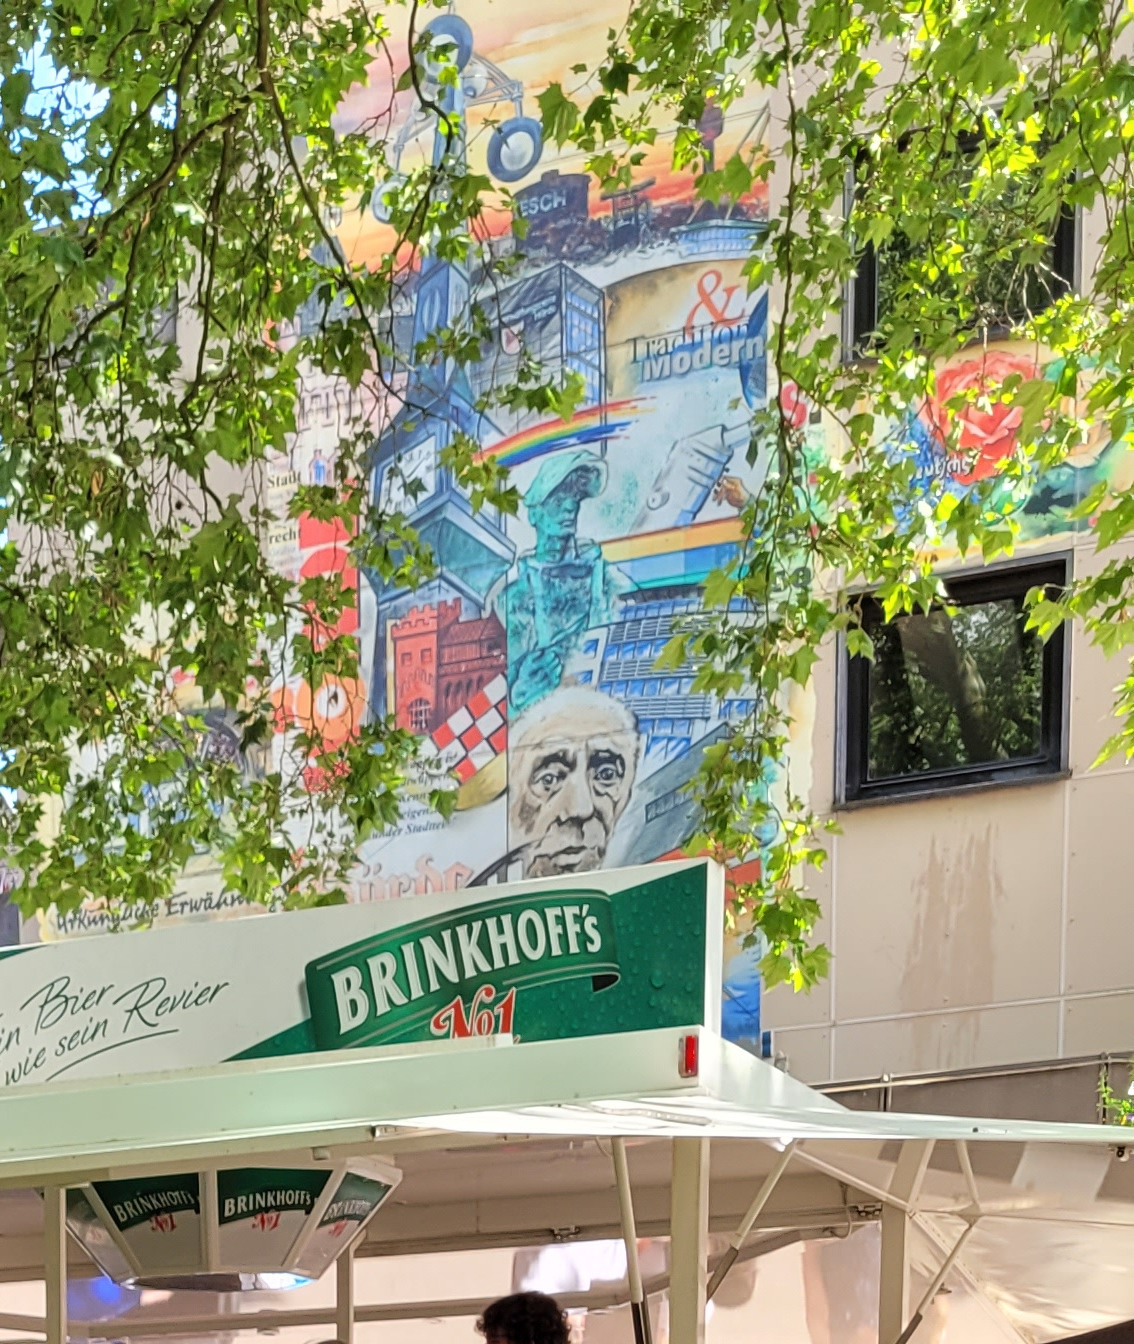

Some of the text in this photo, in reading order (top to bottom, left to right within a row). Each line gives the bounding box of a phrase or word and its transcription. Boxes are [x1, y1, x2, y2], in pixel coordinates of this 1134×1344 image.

[519, 190, 567, 217] ESCH
[641, 336, 765, 383] Modern
[4, 976, 230, 1087] wie sein Revier
[19, 975, 115, 1036] Bier
